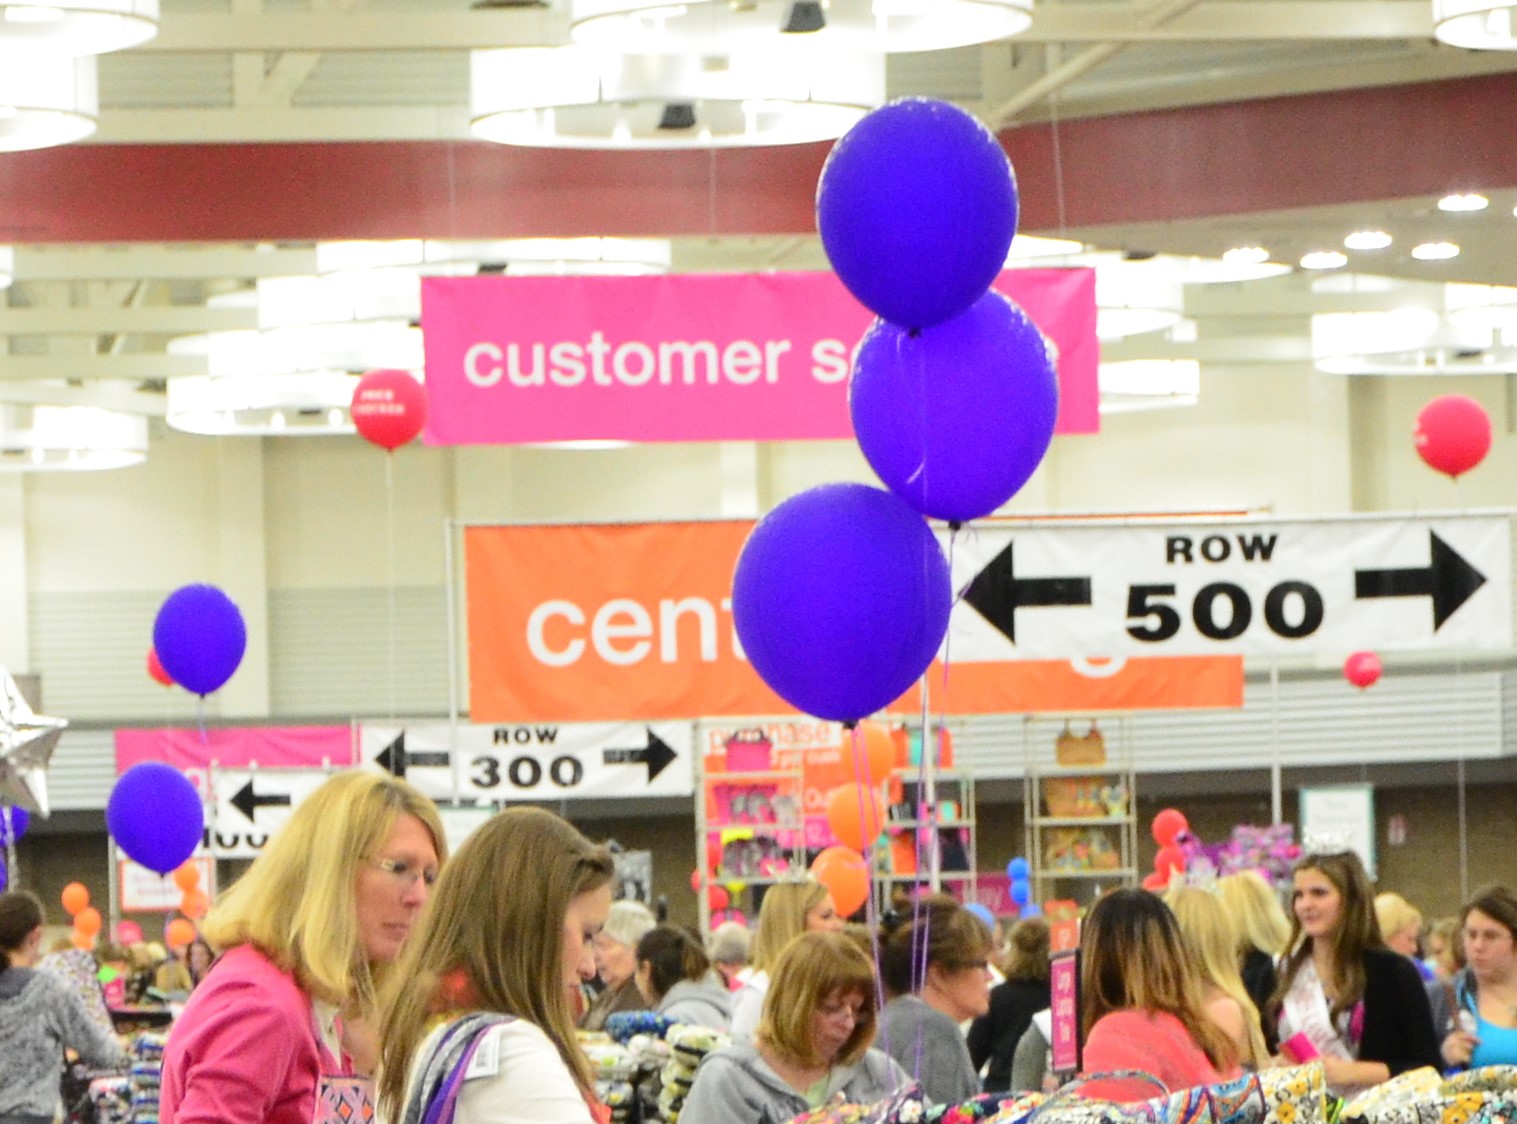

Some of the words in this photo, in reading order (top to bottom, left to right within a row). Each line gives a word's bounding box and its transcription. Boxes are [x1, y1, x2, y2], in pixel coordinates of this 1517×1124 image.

[463, 331, 791, 387] customer
[1166, 533, 1278, 564] ROW
[1125, 580, 1325, 642] 500
[493, 727, 559, 745] ROW
[470, 755, 585, 788] 300
